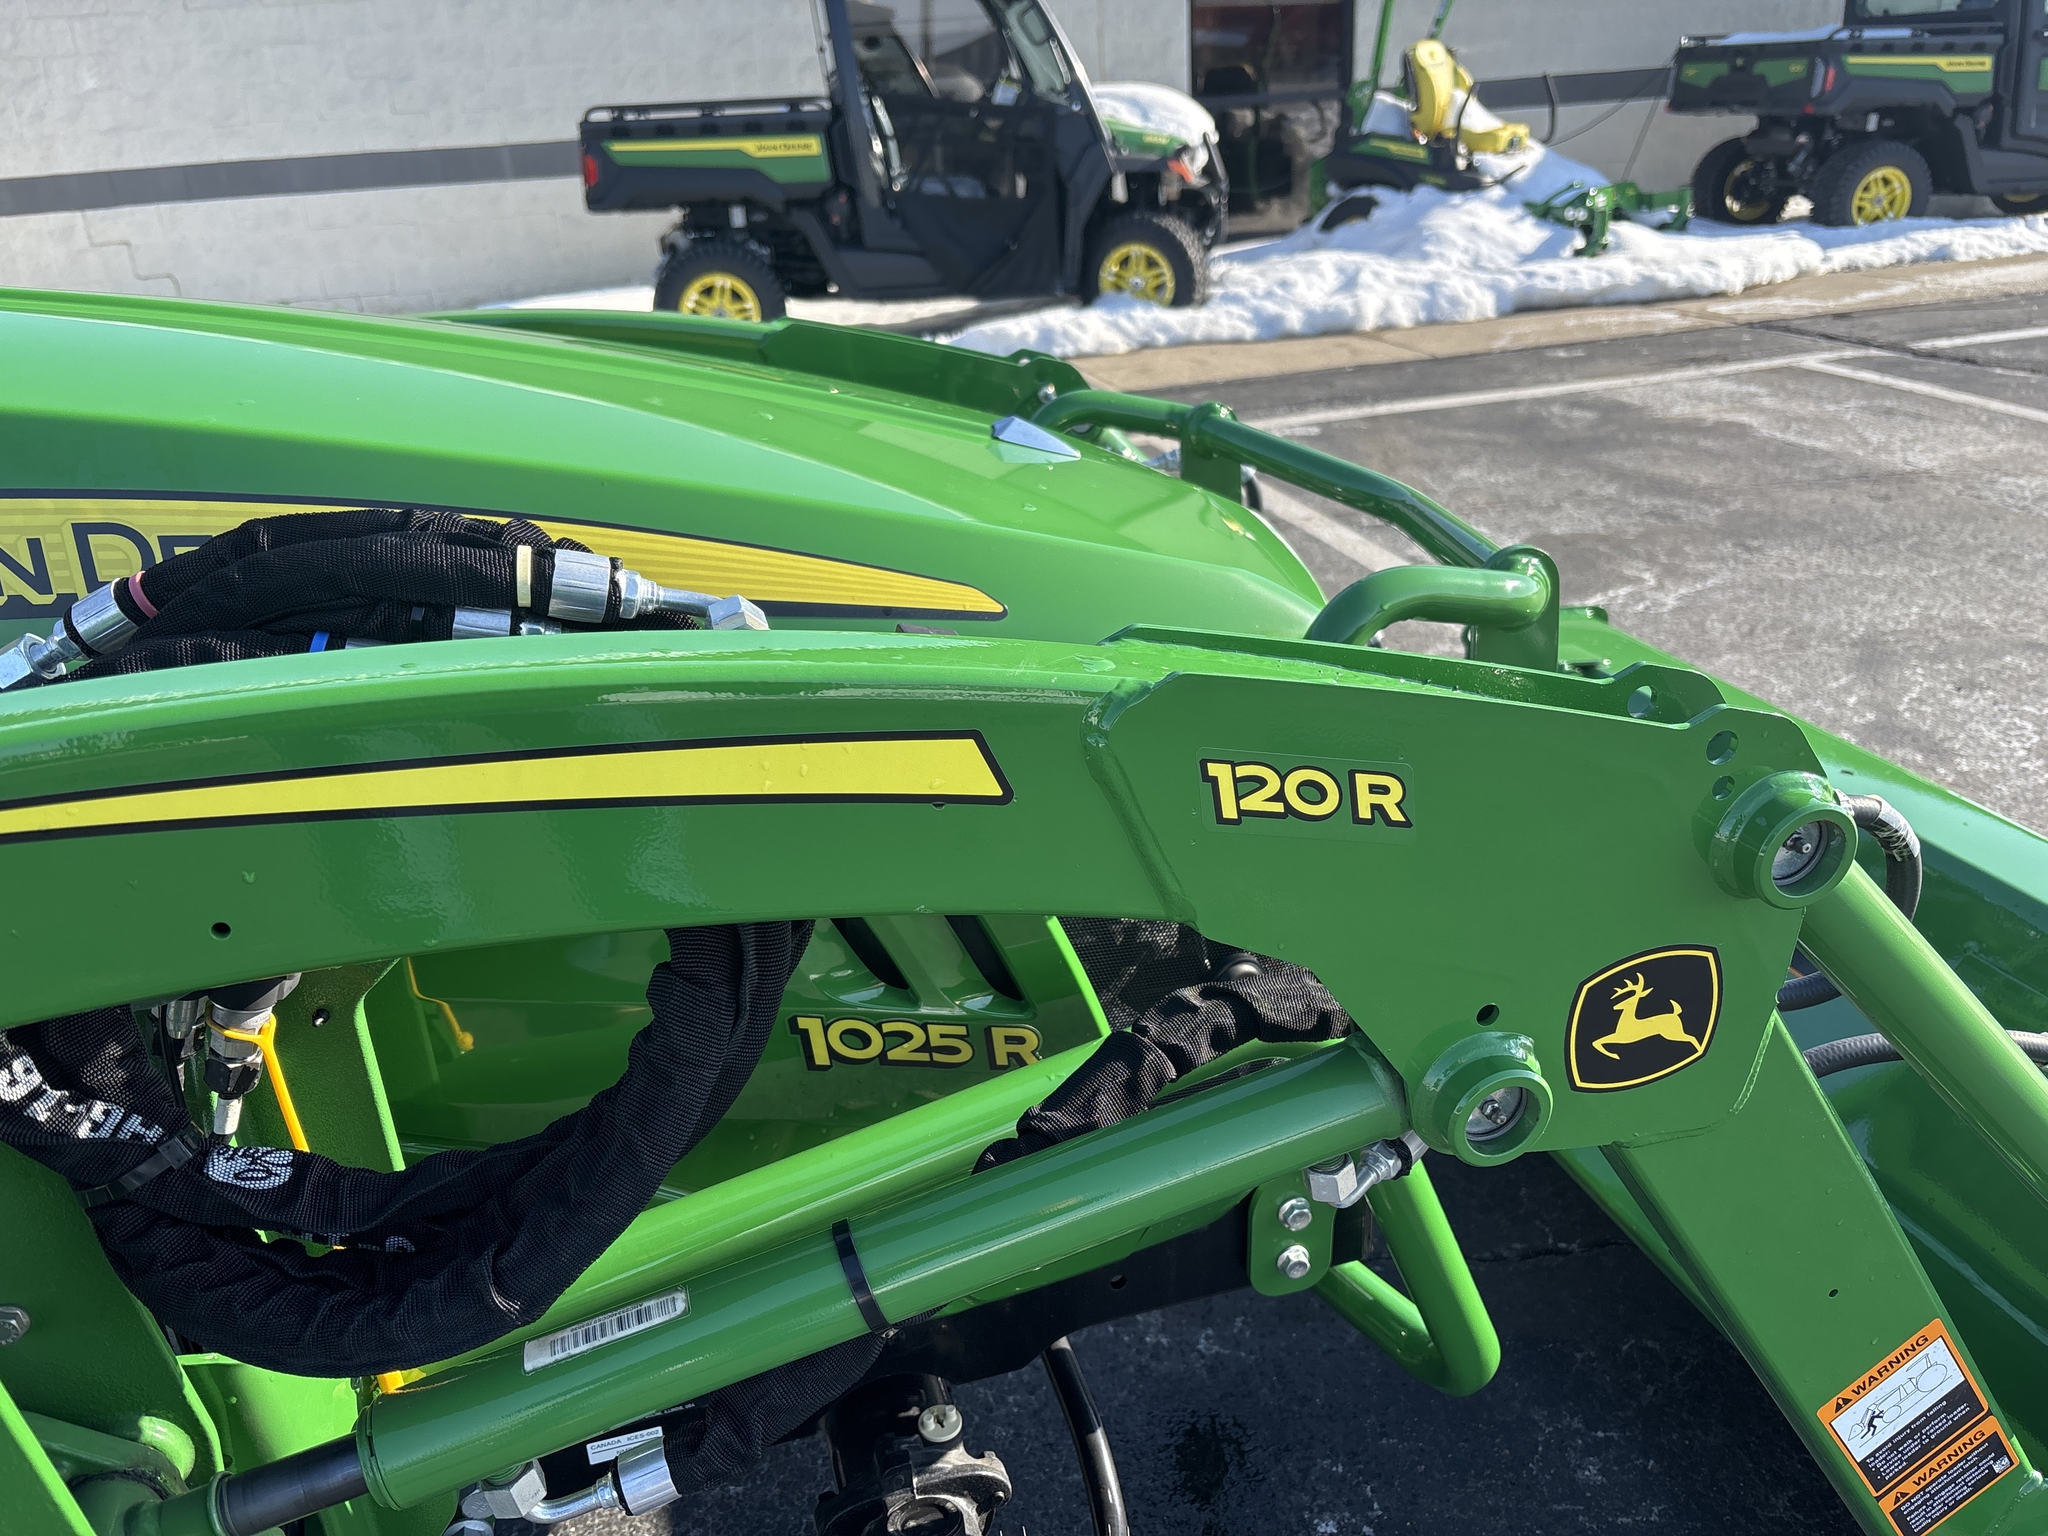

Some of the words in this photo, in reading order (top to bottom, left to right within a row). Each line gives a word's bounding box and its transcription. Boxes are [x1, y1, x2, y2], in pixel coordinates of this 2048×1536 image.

[1199, 758, 1343, 826] 120
[1348, 769, 1414, 829] R
[788, 1014, 975, 1072] 1025
[984, 1025, 1042, 1070] R
[1851, 1333, 1929, 1397] WARNING
[590, 1438, 622, 1451] CANADA
[626, 1429, 660, 1442] ICES-002
[1865, 1455, 1874, 1464] To
[1874, 1441, 1892, 1457] avoid
[1892, 1427, 1911, 1444] injury
[1910, 1415, 1926, 1429] from
[1926, 1399, 1947, 1417] falling
[1875, 1459, 1885, 1468] Do
[1886, 1450, 1897, 1460] not
[1897, 1438, 1912, 1452] walk
[1921, 1411, 1947, 1434] perform
[1879, 1452, 1902, 1472] service
[1901, 1437, 1921, 1454] under
[1926, 1417, 1947, 1435] raised
[1881, 1459, 1901, 1476] Lower
[1901, 1443, 1921, 1460] loader
[1921, 1437, 1929, 1445] to
[1929, 1419, 1953, 1440] ground
[1952, 1405, 1970, 1421] when
[1912, 1427, 1985, 1488] WARNING
[1900, 1501, 1911, 1511] DO
[1910, 1490, 1925, 1503] NOT
[1924, 1473, 1947, 1493] operate
[1946, 1458, 1966, 1475] loader
[1965, 1441, 1988, 1461] without
[1902, 1492, 1930, 1515] engaging
[1929, 1467, 1963, 1494] attachment
[1906, 1503, 1926, 1521] Failure
[1926, 1498, 1933, 1506] to
[1933, 1481, 1955, 1501] engage
[1955, 1464, 1978, 1484] retainer
[1977, 1451, 1995, 1467] could
[1908, 1510, 1926, 1525] result
[1931, 1479, 1965, 1508] attachment
[1964, 1458, 1994, 1483] detaching
[1911, 1516, 1925, 1529] from
[1925, 1501, 1944, 1518] loader
[1943, 1484, 1967, 1504] causing
[1966, 1467, 1989, 1487] serious
